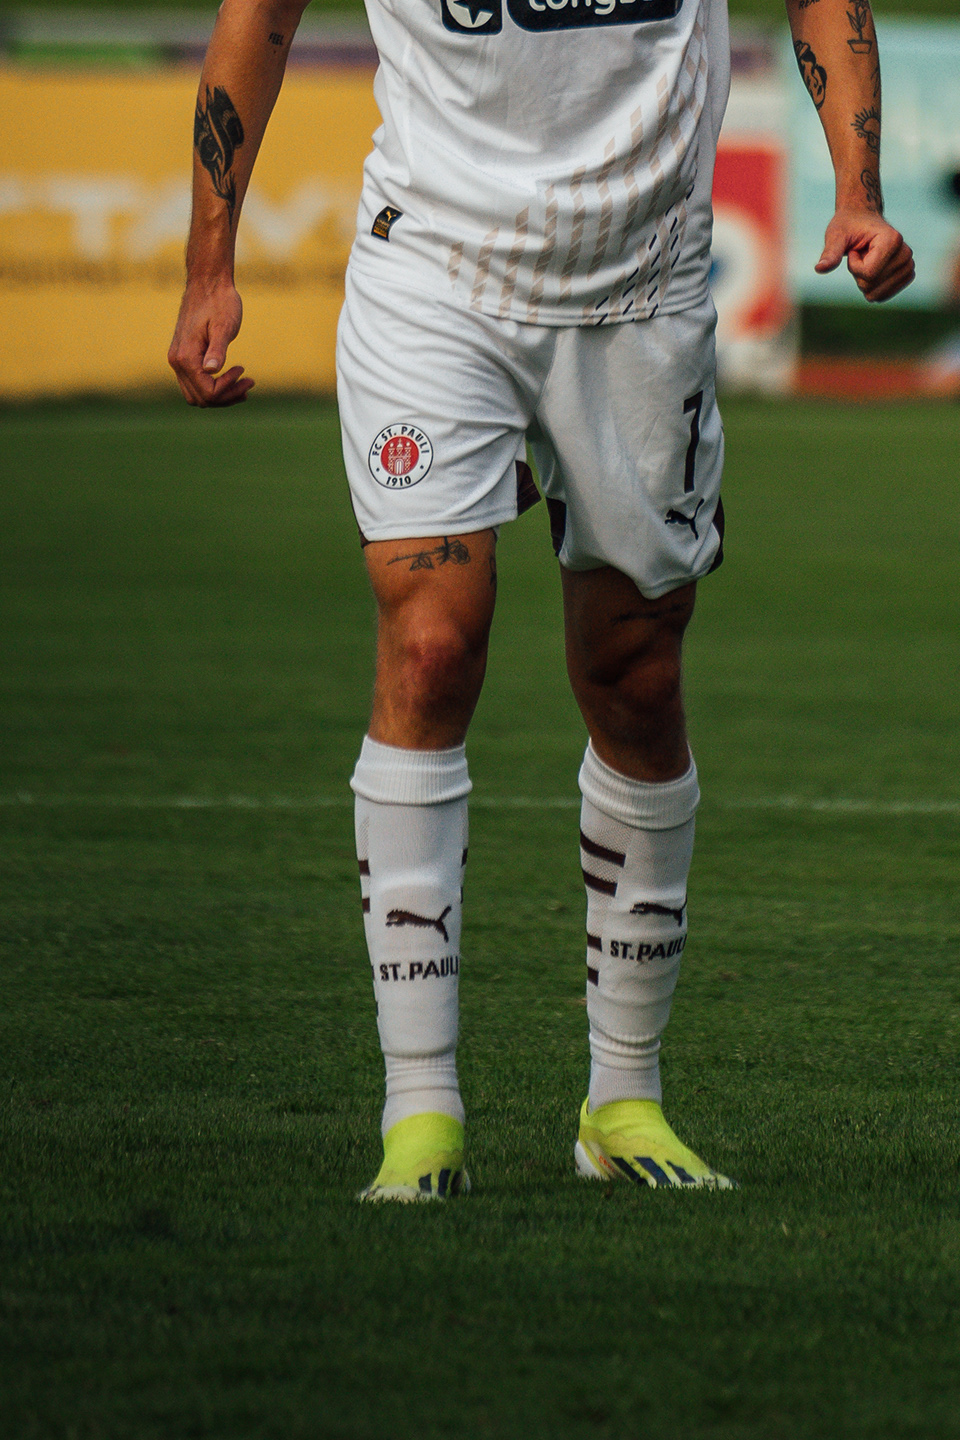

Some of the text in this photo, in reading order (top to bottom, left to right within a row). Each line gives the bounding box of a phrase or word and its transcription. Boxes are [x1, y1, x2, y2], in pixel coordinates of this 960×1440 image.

[372, 426, 429, 456] FC ST. PAULI
[683, 390, 703, 493] 7
[386, 475, 411, 486] 1910
